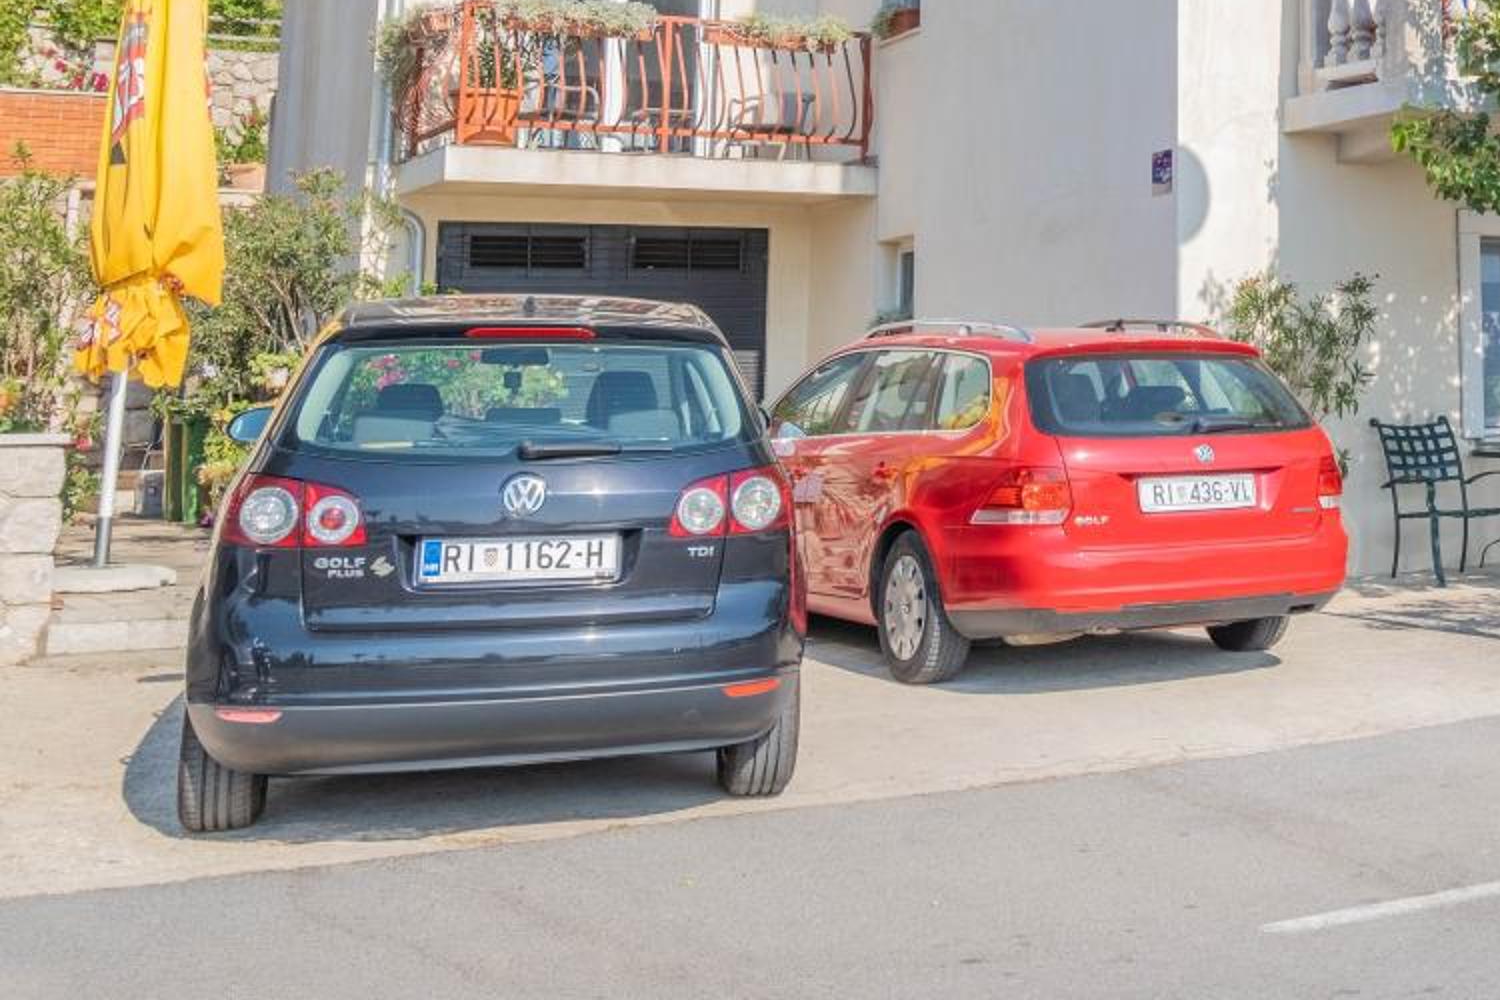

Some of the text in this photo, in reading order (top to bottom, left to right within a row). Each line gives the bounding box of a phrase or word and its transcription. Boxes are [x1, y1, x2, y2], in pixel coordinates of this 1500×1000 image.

[1152, 483, 1173, 505] RI
[443, 540, 603, 573] RI 1162-H
[687, 546, 714, 557] TDI
[313, 557, 366, 570] GOLF
[327, 569, 365, 579] PLUS
